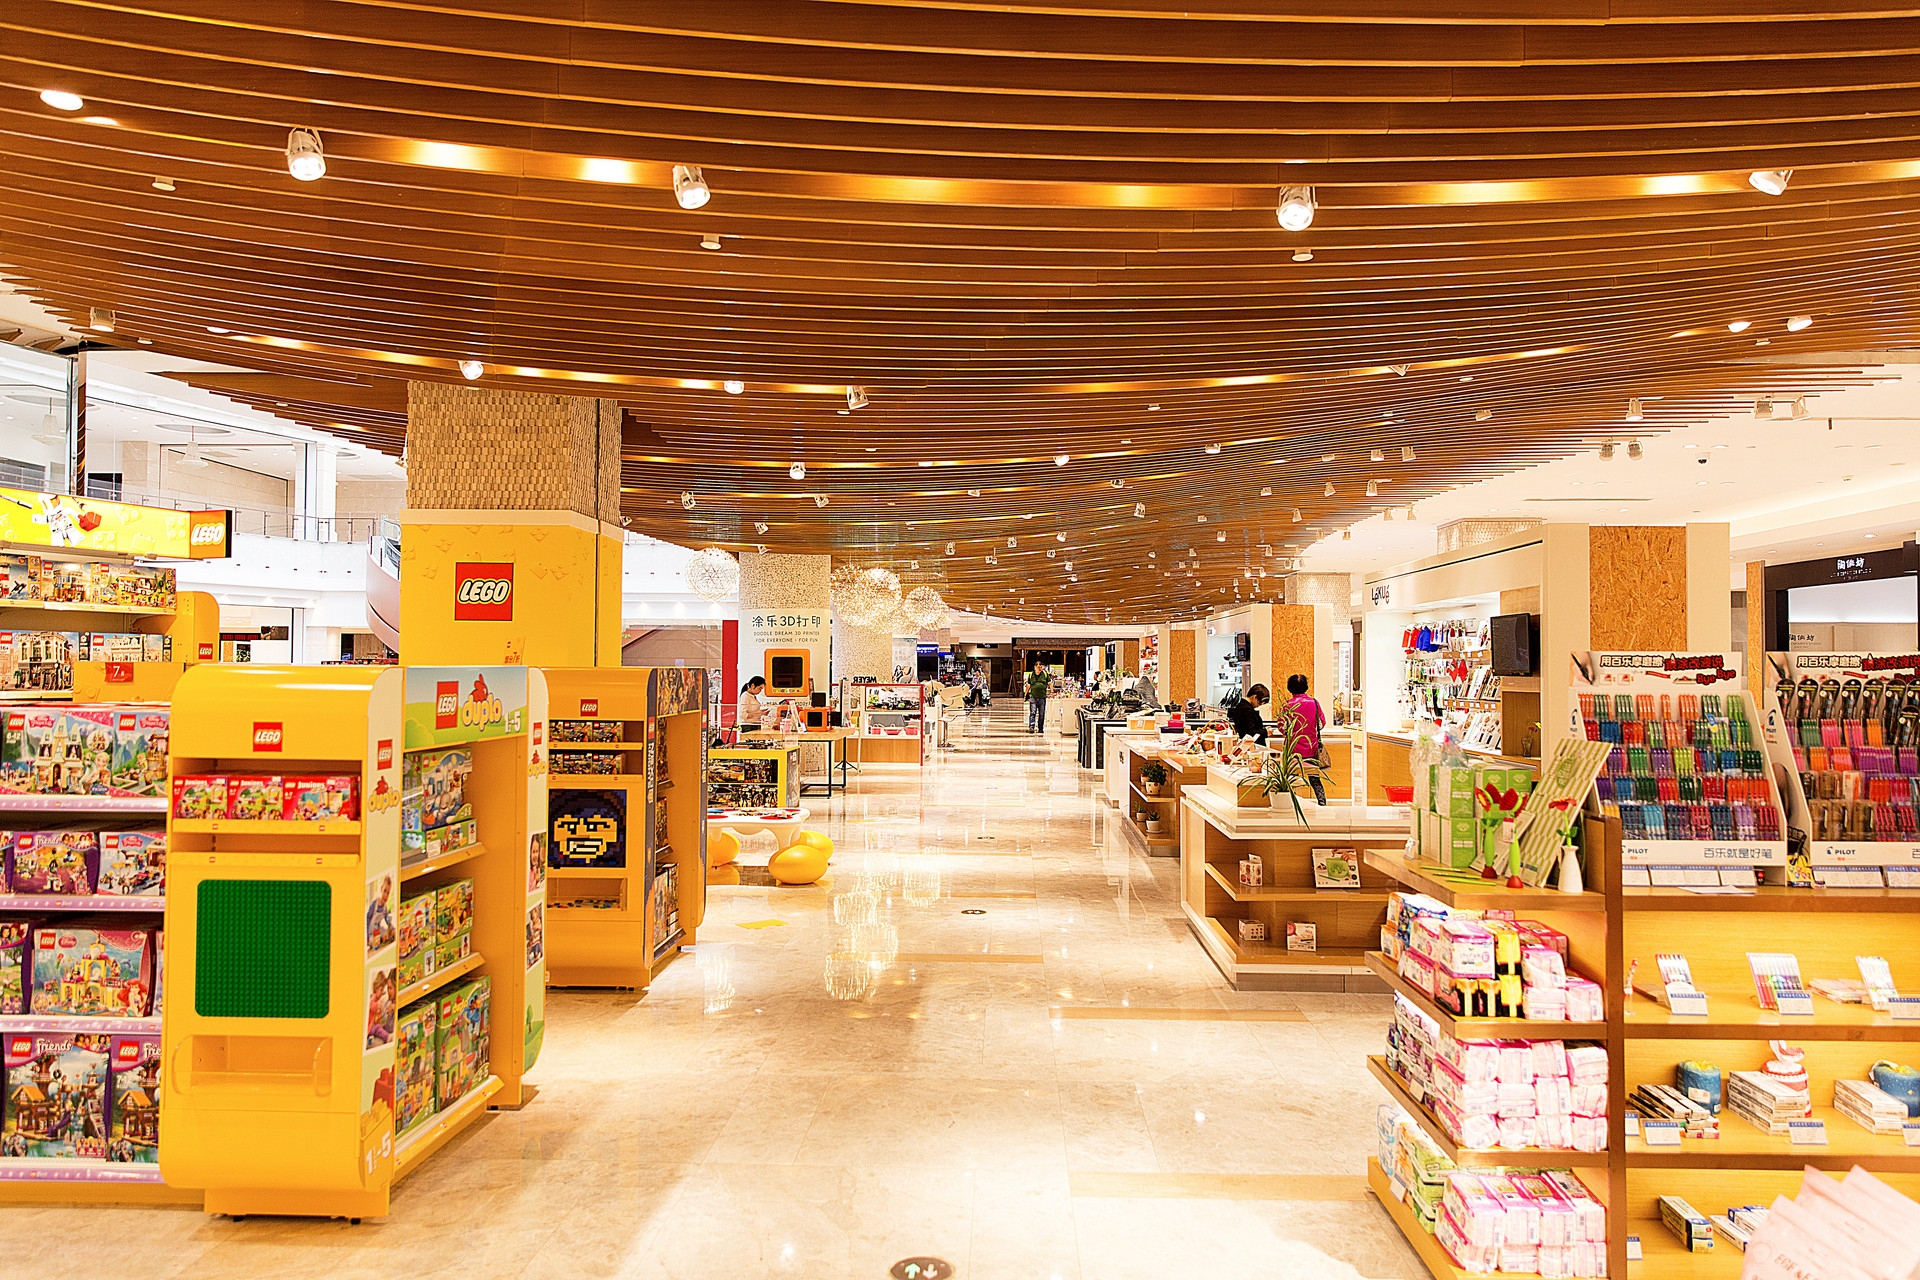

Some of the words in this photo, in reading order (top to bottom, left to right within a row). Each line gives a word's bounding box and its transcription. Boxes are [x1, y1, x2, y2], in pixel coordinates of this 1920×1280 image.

[191, 524, 224, 544] LEGO
[459, 580, 509, 603] LEGO
[752, 614, 821, 628] 涂乐3D打印
[199, 647, 213, 655] LEGO
[1697, 674, 1716, 686] Bye
[1717, 668, 1737, 680] Bye
[438, 695, 457, 715] LEGO
[581, 703, 598, 712] LEGO
[254, 730, 281, 744] LEGO
[378, 747, 392, 763] LEGO
[1703, 847, 1773, 860] 百乐就是好笔
[41, 937, 55, 945] LEGO
[12, 1042, 31, 1051] LEGO
[119, 1047, 138, 1055] LEGO
